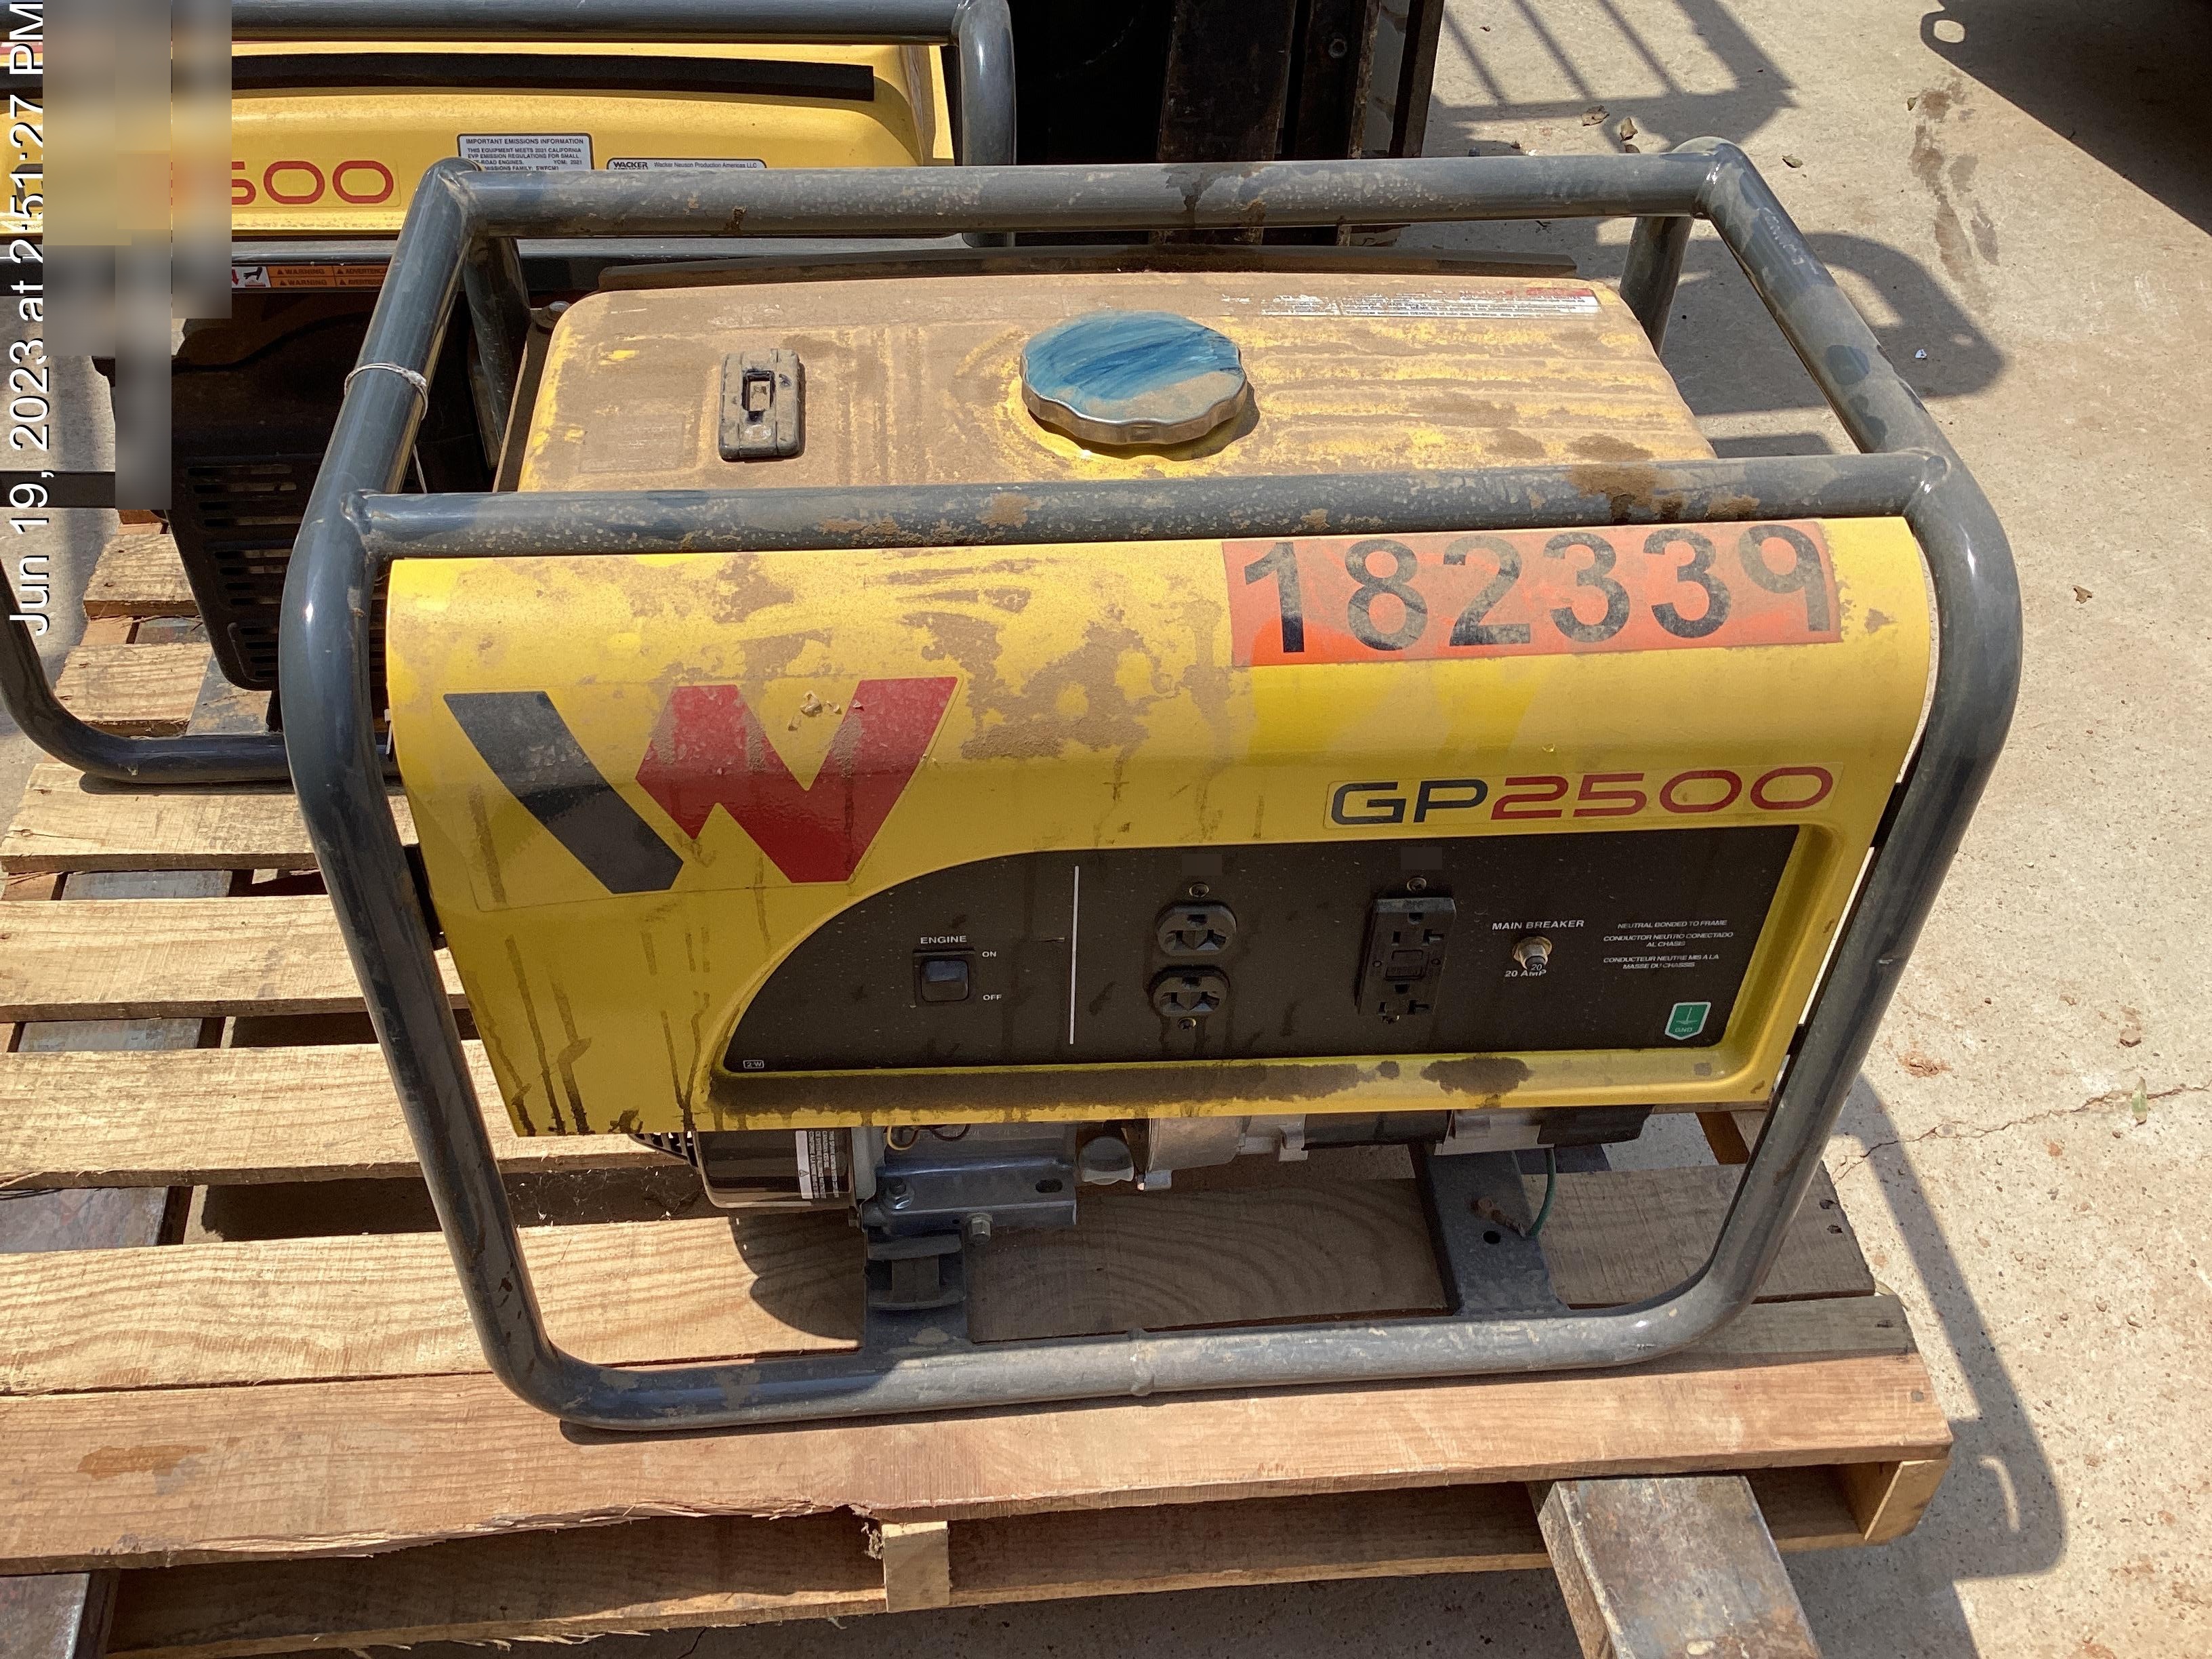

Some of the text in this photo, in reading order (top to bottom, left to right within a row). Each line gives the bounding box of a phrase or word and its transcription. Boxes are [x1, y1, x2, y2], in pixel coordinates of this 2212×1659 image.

[1244, 523, 1831, 653] 182339
[1330, 766, 1834, 825] GP2500
[1492, 920, 1585, 930] MAIN BREAKER
[920, 935, 968, 945] ENGINE
[1603, 934, 1652, 942] CONDUCTOR
[1530, 963, 1542, 971] 20
